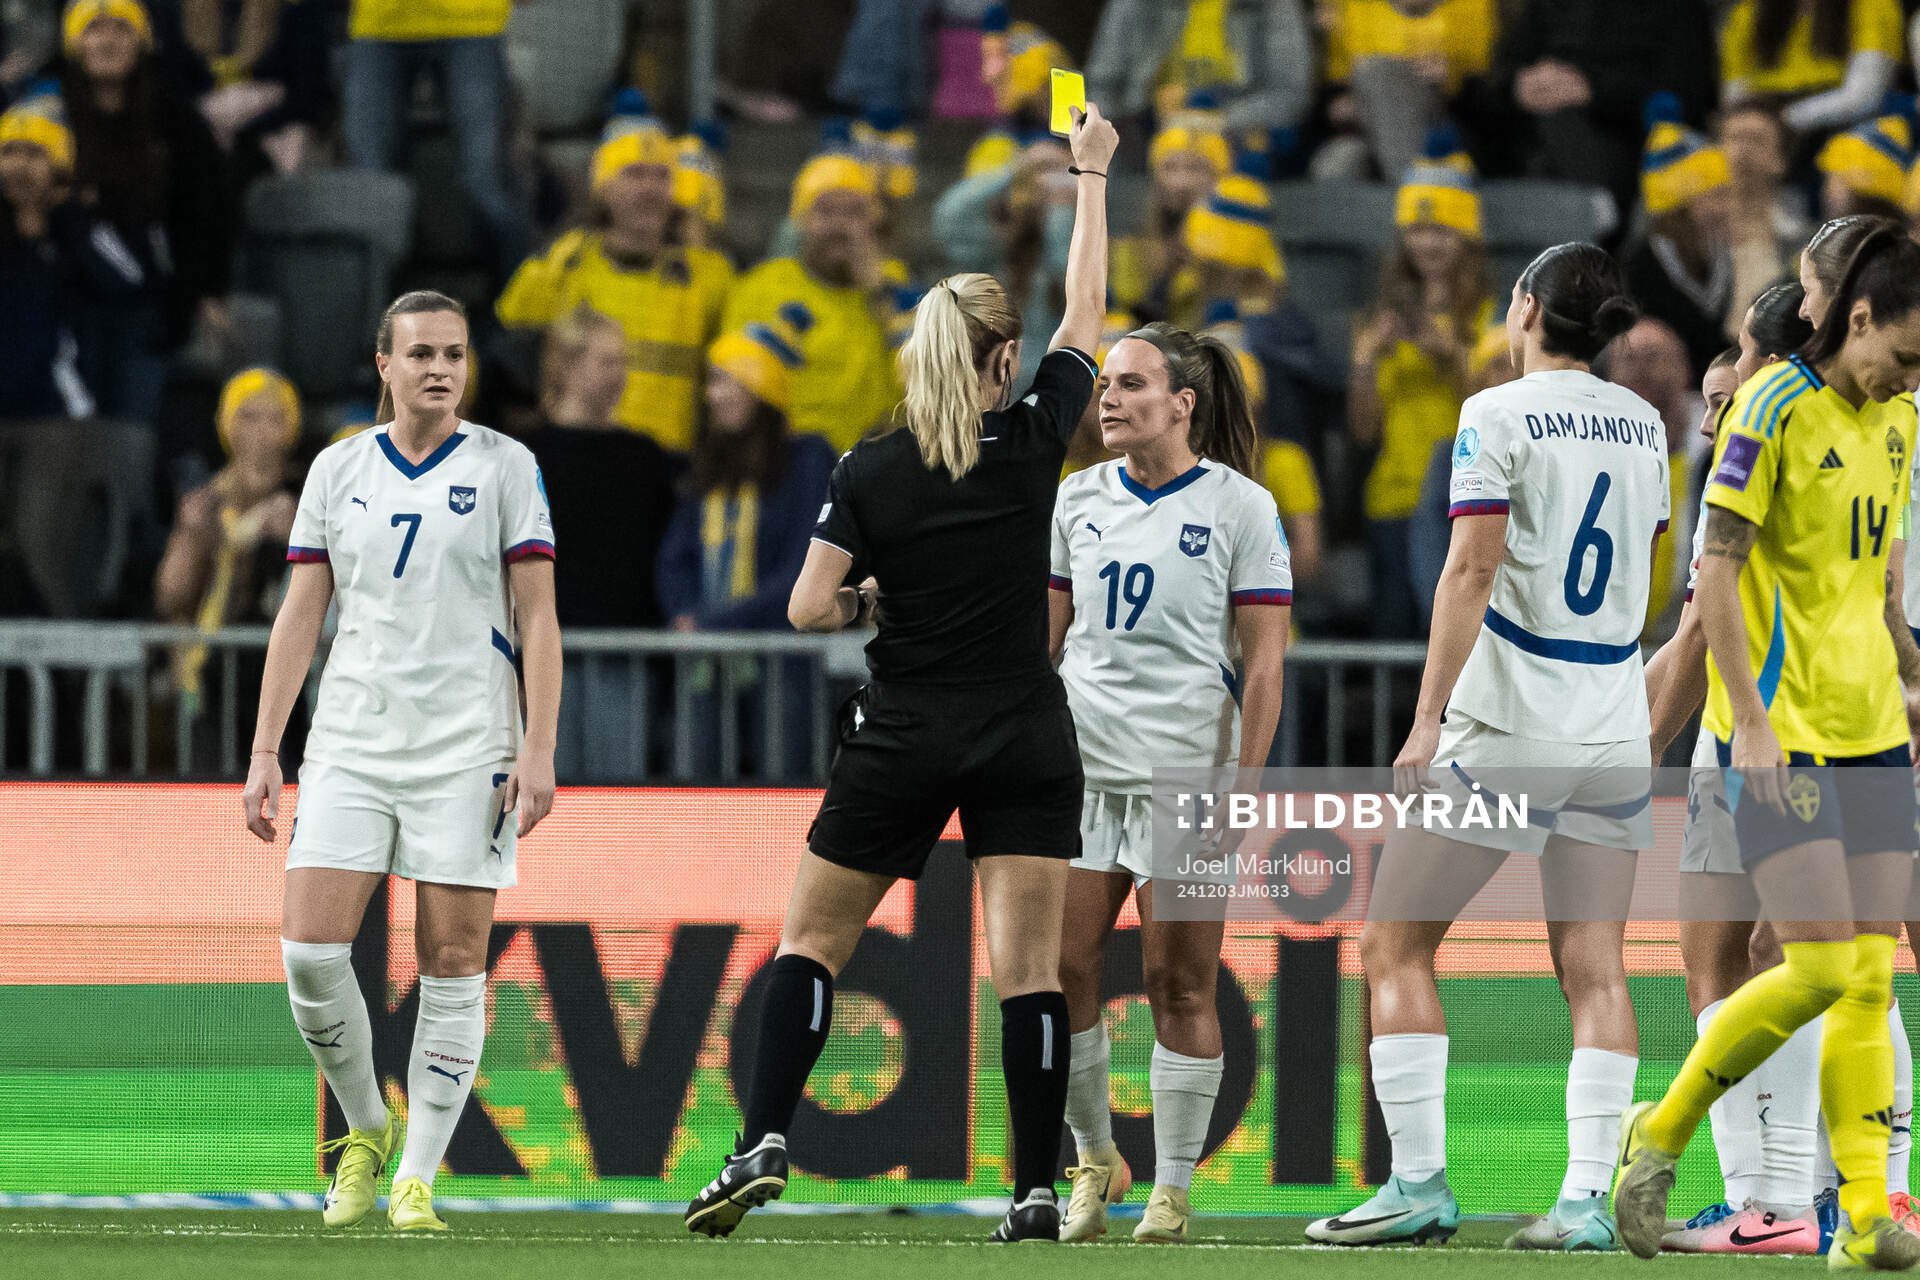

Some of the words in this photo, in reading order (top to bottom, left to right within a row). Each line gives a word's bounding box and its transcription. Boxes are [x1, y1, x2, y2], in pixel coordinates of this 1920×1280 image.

[1525, 412, 1660, 452] DAMJANOVIĆ
[390, 512, 423, 579] 7
[1564, 471, 1614, 617] 6
[1850, 495, 1889, 561] 14
[1098, 560, 1155, 632] 19
